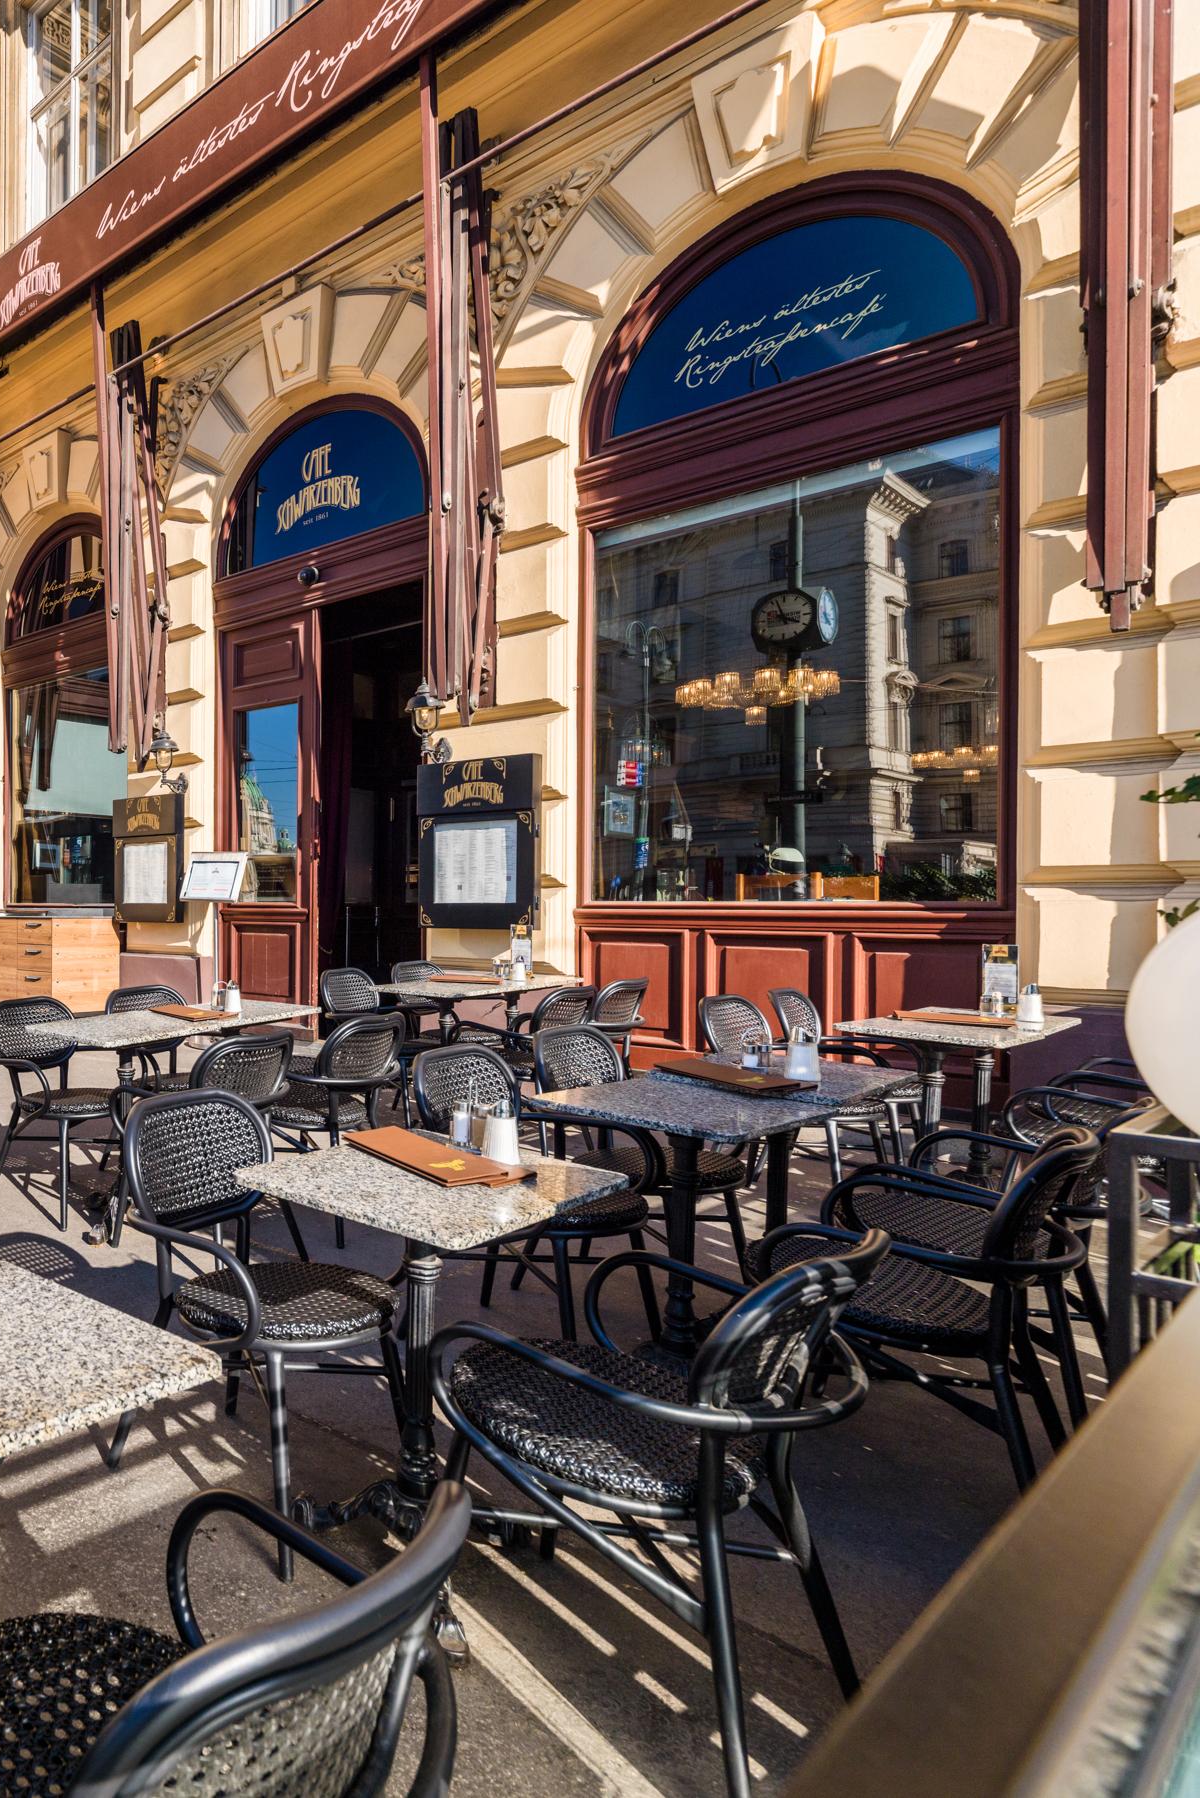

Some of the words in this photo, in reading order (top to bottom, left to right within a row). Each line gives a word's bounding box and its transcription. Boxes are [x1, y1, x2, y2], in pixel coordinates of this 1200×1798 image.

[95, 176, 166, 240] Wiens
[173, 92, 275, 182] ältestes
[0, 261, 61, 331] SCHWARZENBERG
[684, 319, 767, 353] Wiens
[773, 269, 882, 321] ältestes
[275, 475, 360, 535] SCHWARZENBERG
[442, 781, 503, 808] SCHWARZENBERG
